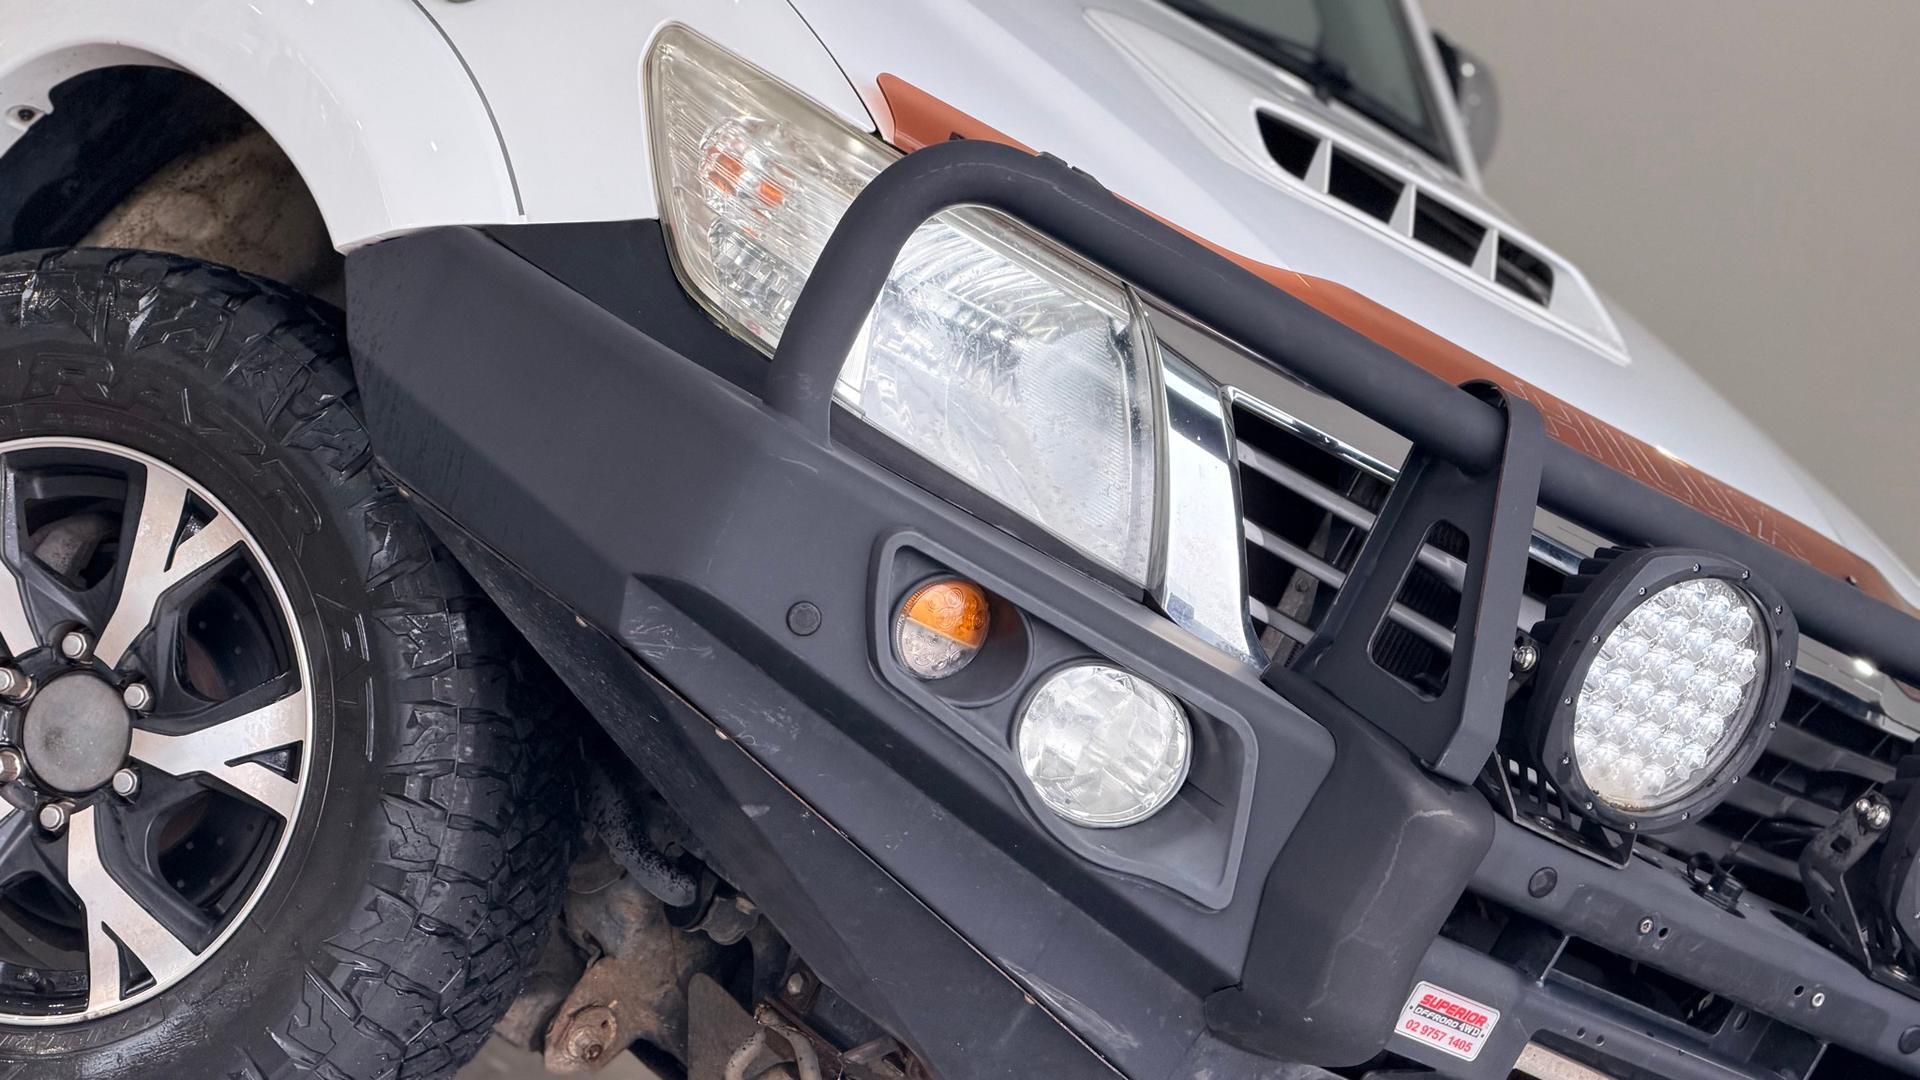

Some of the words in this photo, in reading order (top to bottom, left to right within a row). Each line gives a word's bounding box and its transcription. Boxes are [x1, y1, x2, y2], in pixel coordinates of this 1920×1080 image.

[1414, 1006, 1458, 1028] OFFROAD
[1458, 1023, 1481, 1038] 4WD
[1419, 993, 1488, 1027] SUPERIOR
[1405, 1019, 1419, 1032] 02
[1420, 1025, 1447, 1042] 9757
[1447, 1035, 1473, 1053] 1405
